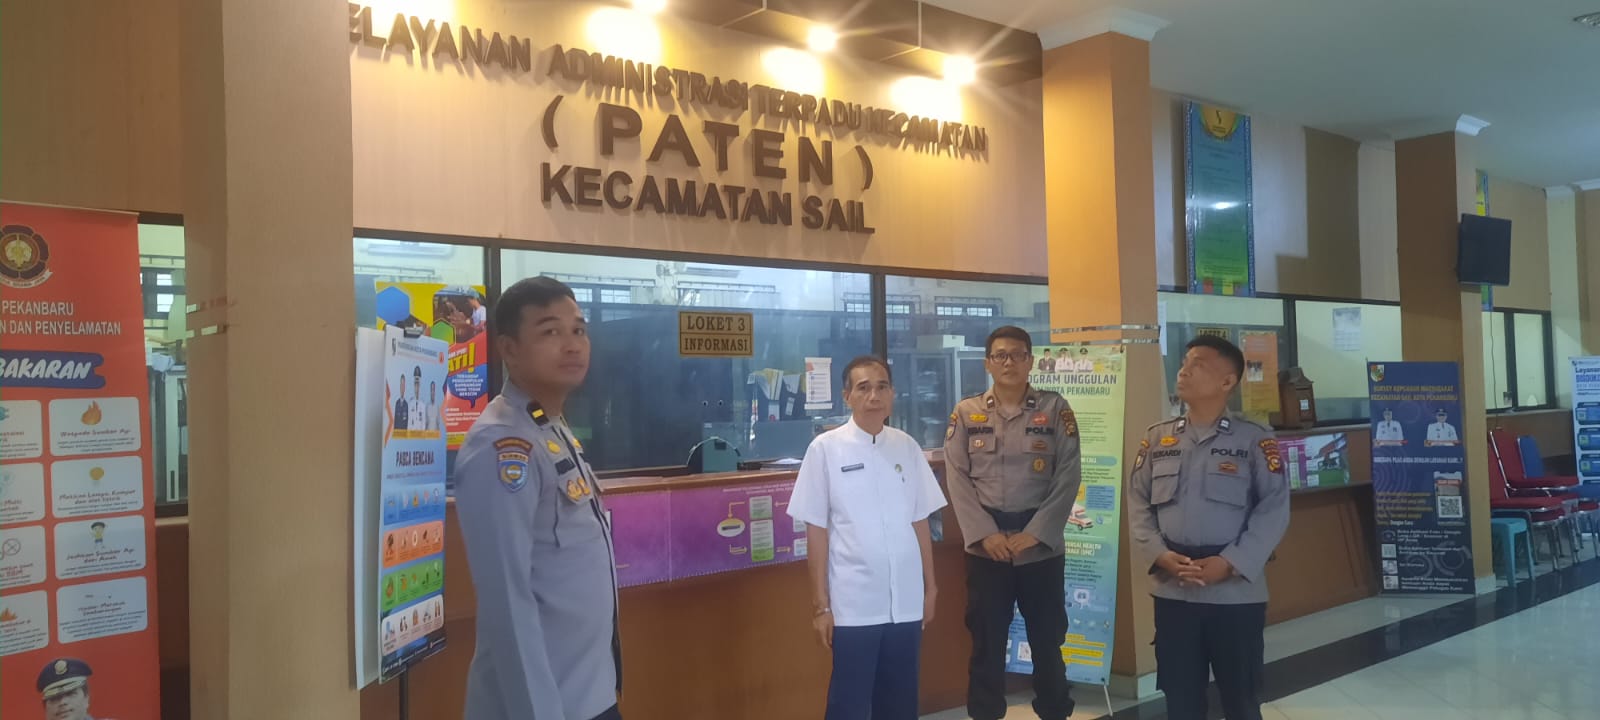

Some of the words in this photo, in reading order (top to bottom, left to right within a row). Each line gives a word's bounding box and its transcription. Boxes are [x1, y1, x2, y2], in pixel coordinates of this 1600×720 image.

[547, 43, 748, 111] ADMINISTRASI
[751, 84, 861, 131] TERPADU
[865, 106, 987, 151] KECAMATAN
[541, 95, 564, 148] (
[598, 102, 833, 186] PATEN
[855, 145, 874, 190] )
[541, 162, 793, 226] KECAMATAN
[801, 195, 876, 234] SAIL
[2, 300, 74, 316] PEKANBARU
[10, 320, 32, 334] DAN
[35, 320, 121, 336] PENYELAMATAN
[687, 315, 734, 331] LOKET
[738, 318, 746, 331] 3
[684, 337, 748, 352] INFORMASI
[1064, 374, 1117, 385] UNGGULAN
[1067, 386, 1111, 396] PEKANBARU
[1211, 448, 1248, 459] POLRI
